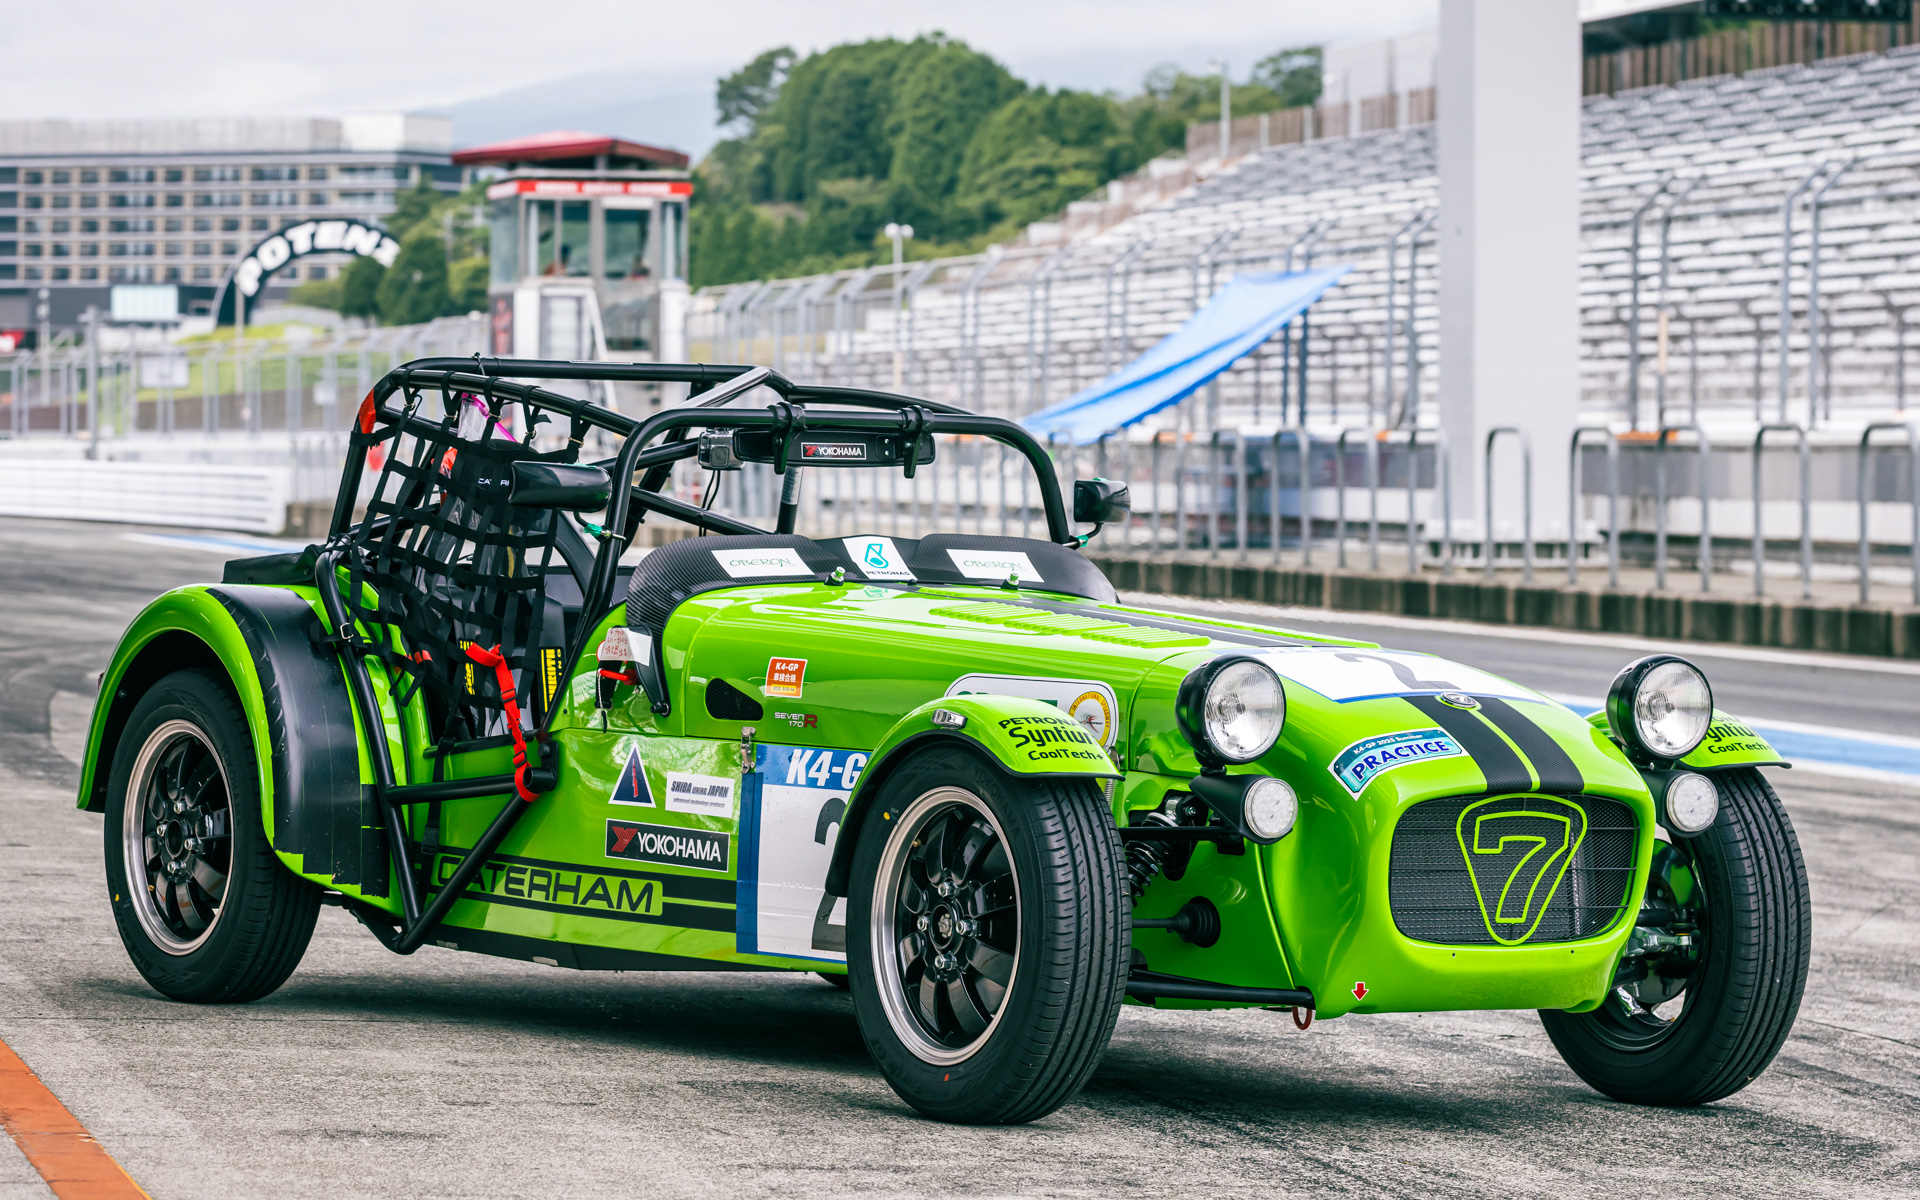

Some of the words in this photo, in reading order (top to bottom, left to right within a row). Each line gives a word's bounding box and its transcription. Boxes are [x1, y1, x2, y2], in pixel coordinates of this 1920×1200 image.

[238, 220, 401, 298] POTENZ
[818, 446, 862, 456] YOKOHAMA
[729, 558, 791, 568] OBERON
[963, 560, 1023, 571] OBERON
[775, 662, 799, 672] K4-GP
[774, 712, 804, 720] SEVEN
[998, 717, 1081, 729] PETRONA
[789, 720, 804, 728] 170
[1353, 742, 1377, 755] K4-GP
[1376, 736, 1396, 746] 2025
[1395, 734, 1423, 742] Summer
[1351, 740, 1450, 781] PRACTICE
[785, 749, 867, 790] K4-G
[671, 780, 693, 794] SHIBA
[707, 785, 730, 798] JAPAN
[638, 832, 721, 862] YOKOHAMA
[1474, 810, 1571, 924] 7
